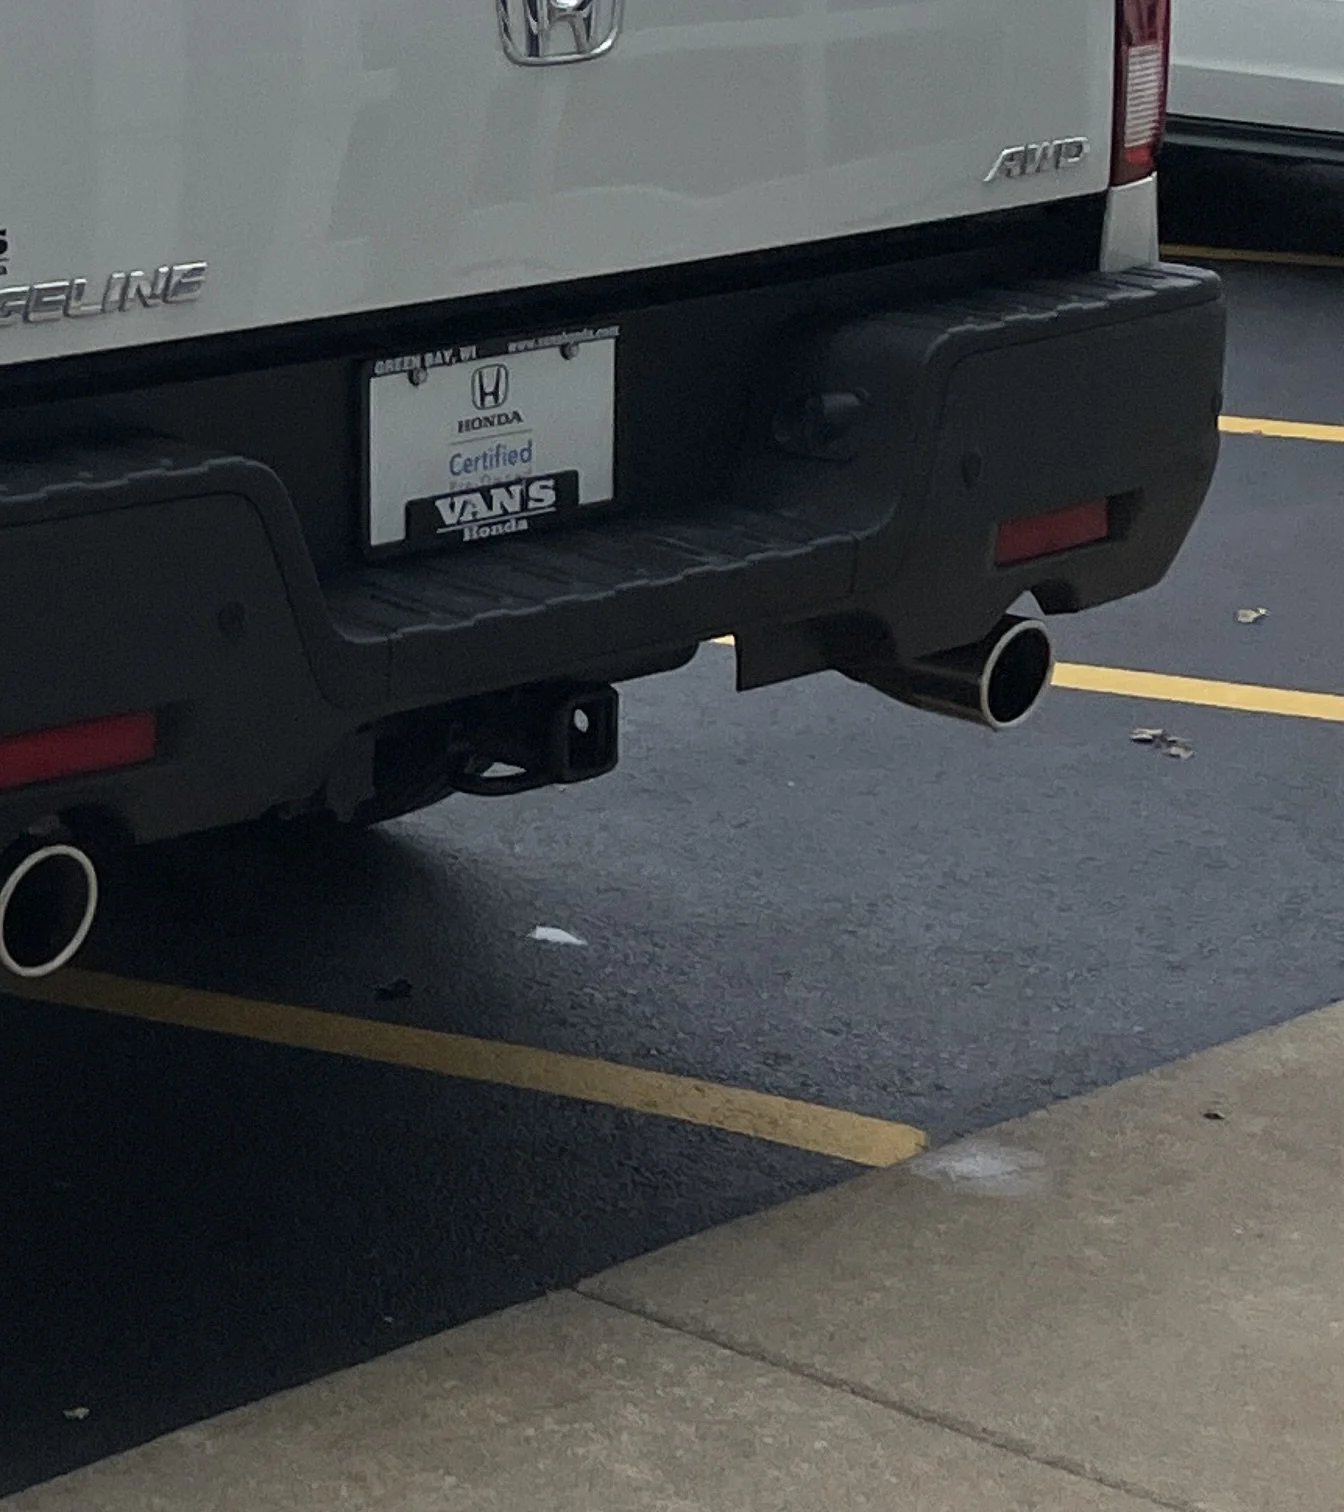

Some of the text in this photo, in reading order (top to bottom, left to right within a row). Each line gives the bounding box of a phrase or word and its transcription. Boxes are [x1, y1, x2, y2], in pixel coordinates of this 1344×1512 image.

[983, 136, 1091, 182] AWD
[375, 354, 421, 374] GREEN
[458, 411, 523, 433] HONDA
[450, 440, 532, 476] Certified
[463, 518, 529, 542] Honda
